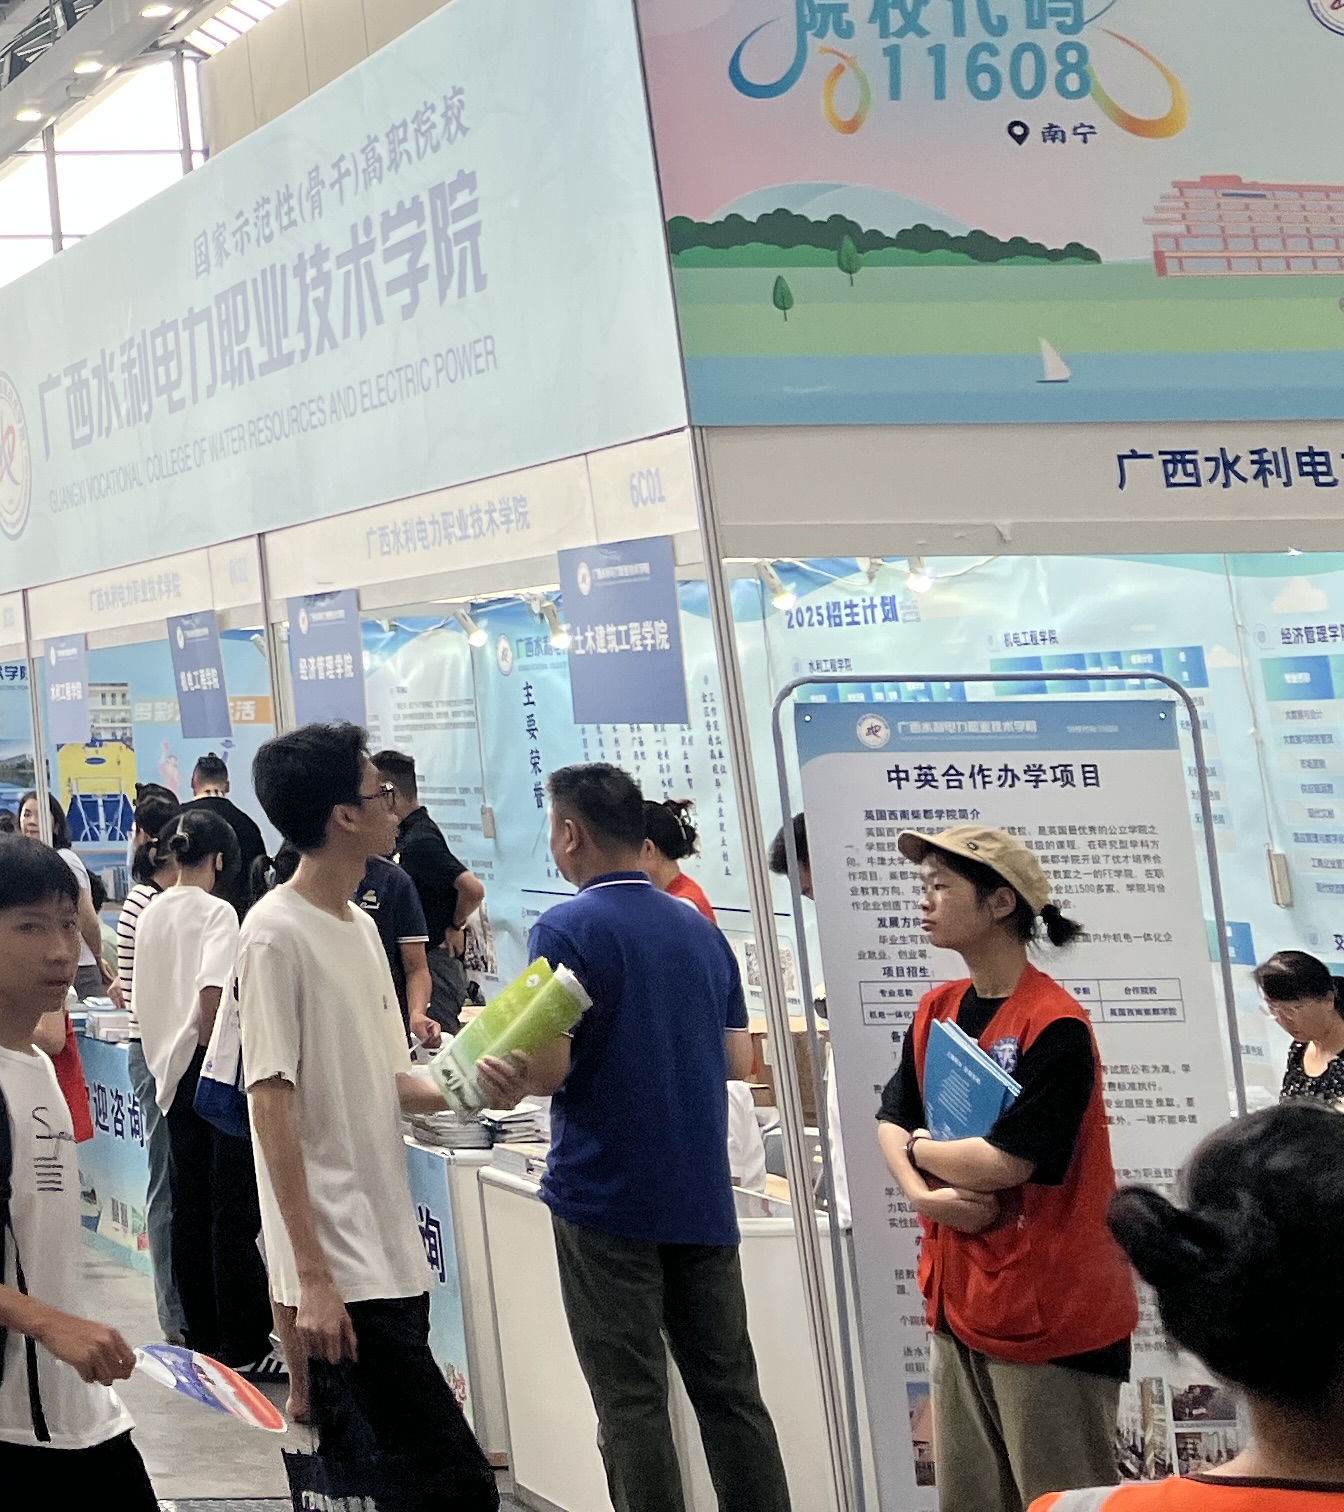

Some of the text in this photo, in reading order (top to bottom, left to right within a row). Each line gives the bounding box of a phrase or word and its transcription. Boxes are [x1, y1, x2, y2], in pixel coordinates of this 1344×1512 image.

[881, 41, 1091, 102] 11608
[1040, 120, 1098, 145] 南宁
[37, 168, 488, 462] 广西水利电力职业技术学院
[49, 335, 498, 515] GUANGXI VOCATIONAL COLLEGE OF WATER RESOURCES AND ELECTRIC POWER
[629, 467, 666, 510] 6C01
[1116, 446, 1344, 490] 广西水利电
[366, 495, 531, 560] 广西水利电力职业技术学院
[785, 595, 900, 630] 2025招生计划
[573, 619, 669, 655] 土木建筑工程学院
[1004, 629, 1059, 647] 机电工程学院
[298, 652, 354, 680] 经济管理学院
[522, 681, 545, 809] 主要荣誉
[886, 763, 1102, 790] 中英合作办学项目
